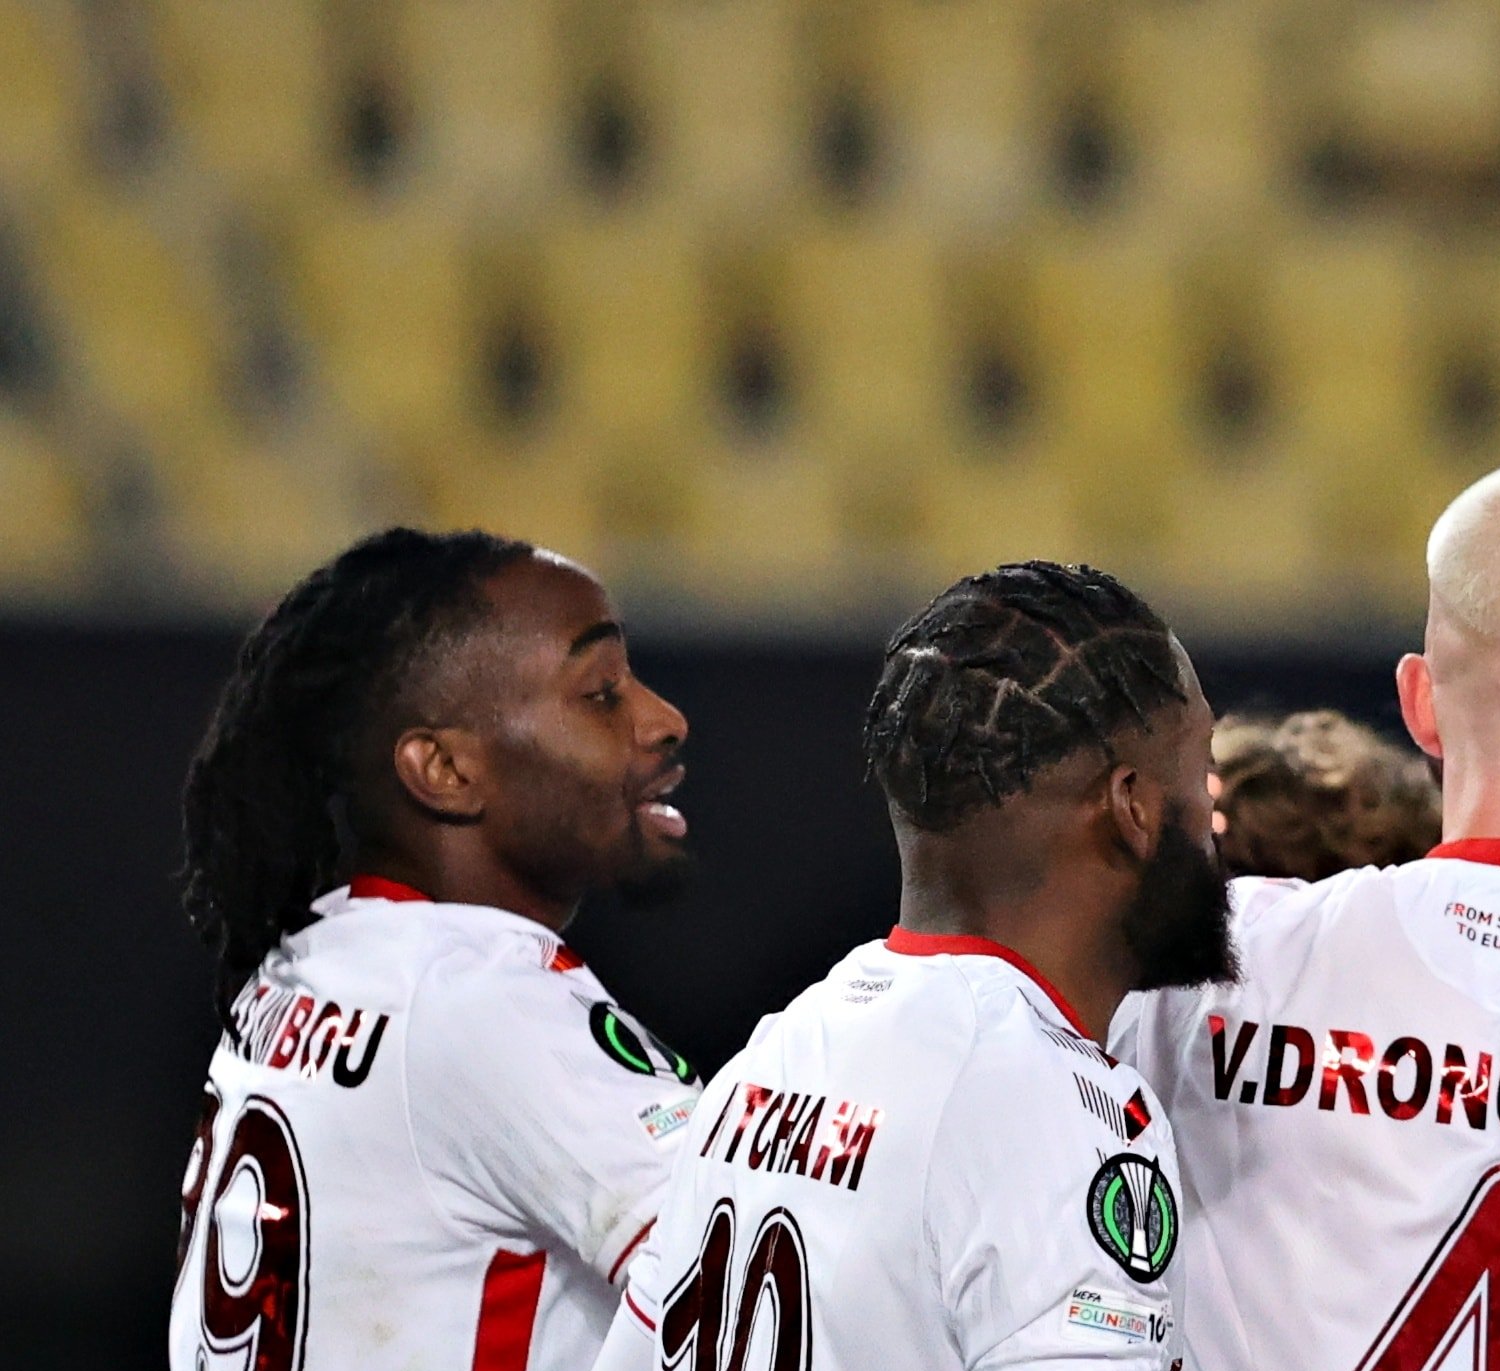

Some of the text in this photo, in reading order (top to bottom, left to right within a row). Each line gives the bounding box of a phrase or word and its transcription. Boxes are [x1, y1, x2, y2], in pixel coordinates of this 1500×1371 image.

[1444, 902, 1493, 926] FROM
[1457, 921, 1477, 941] TO
[1073, 1289, 1102, 1303] UEFA
